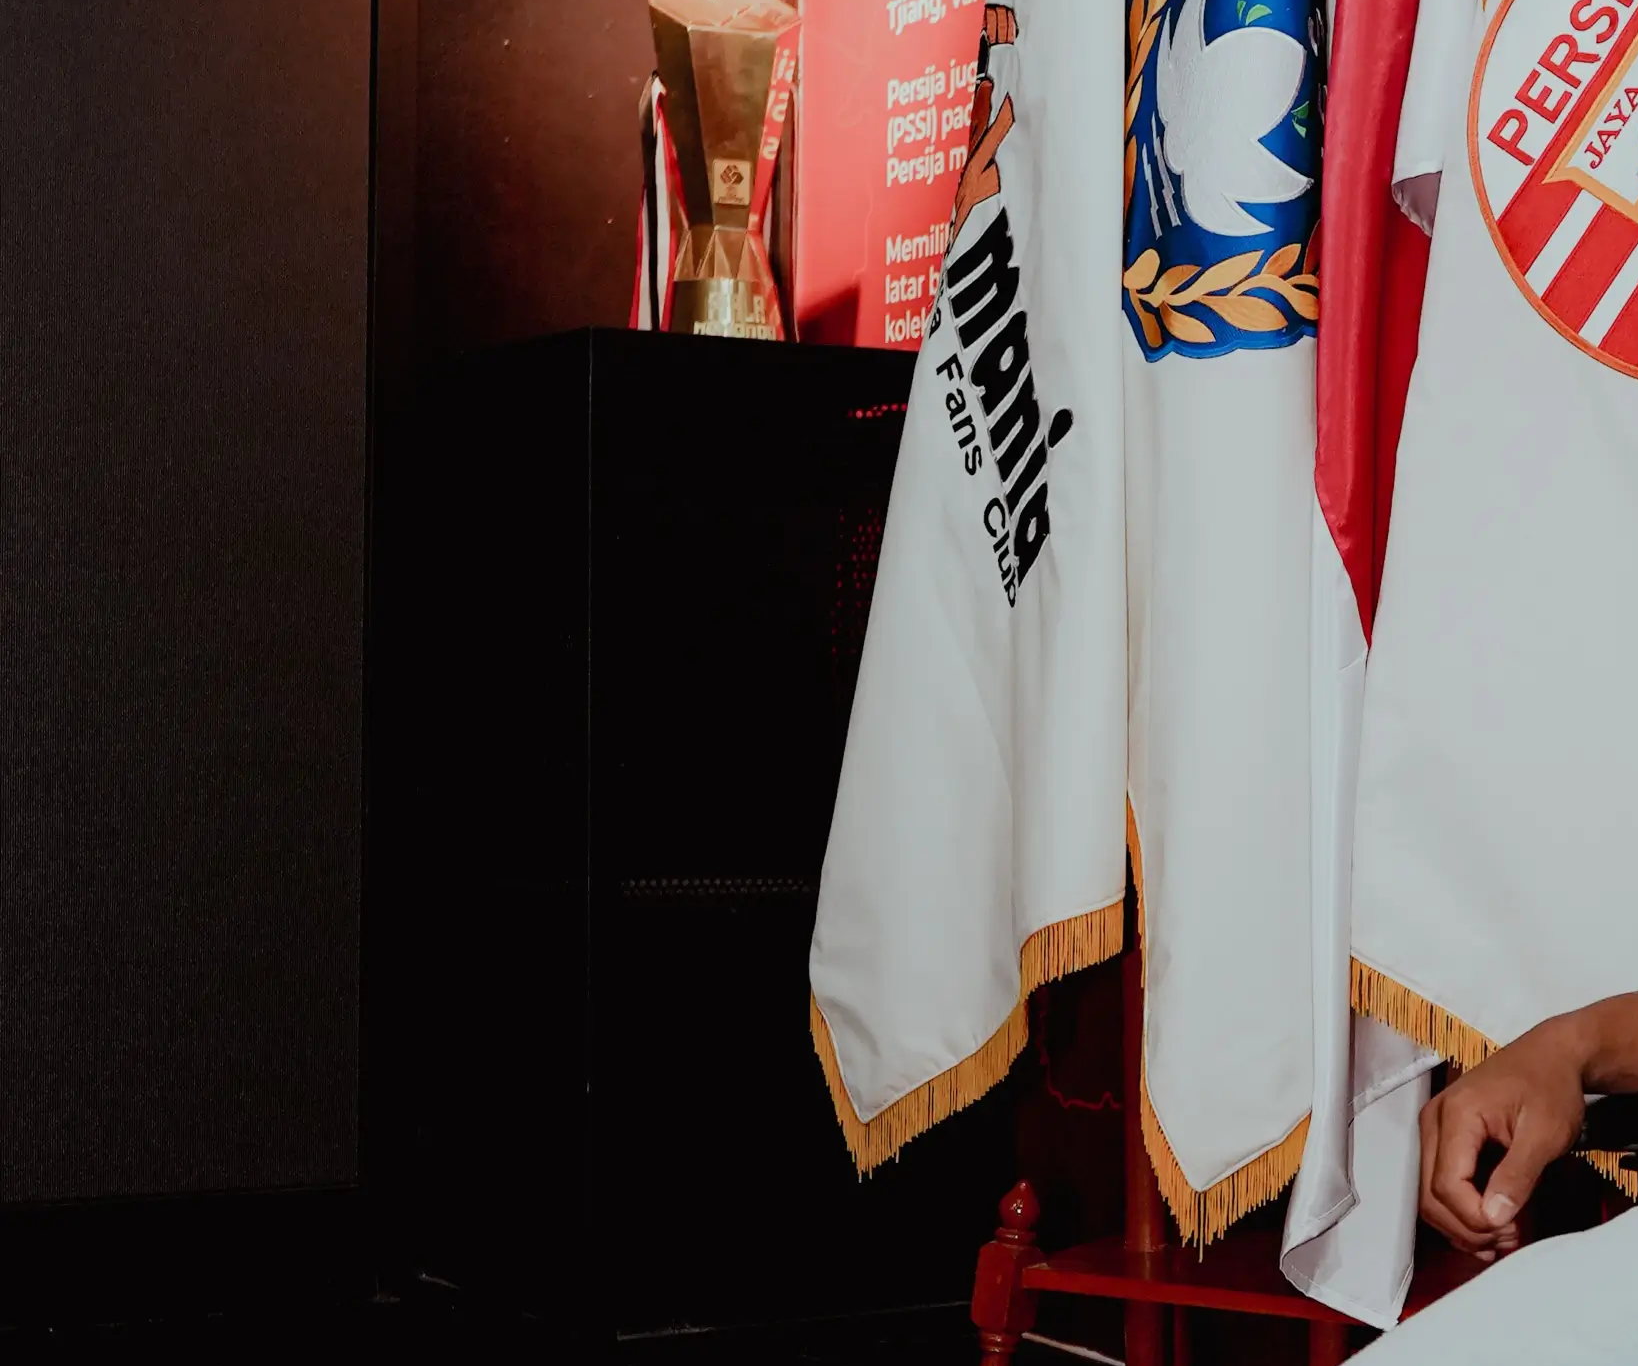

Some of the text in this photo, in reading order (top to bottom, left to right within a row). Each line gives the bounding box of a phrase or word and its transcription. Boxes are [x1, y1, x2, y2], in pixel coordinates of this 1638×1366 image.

[887, 64, 946, 111] Persija
[886, 105, 936, 155] (PSSI)
[886, 145, 944, 188] Persija
[885, 270, 924, 305] latar
[935, 352, 1018, 609] Fans Club
